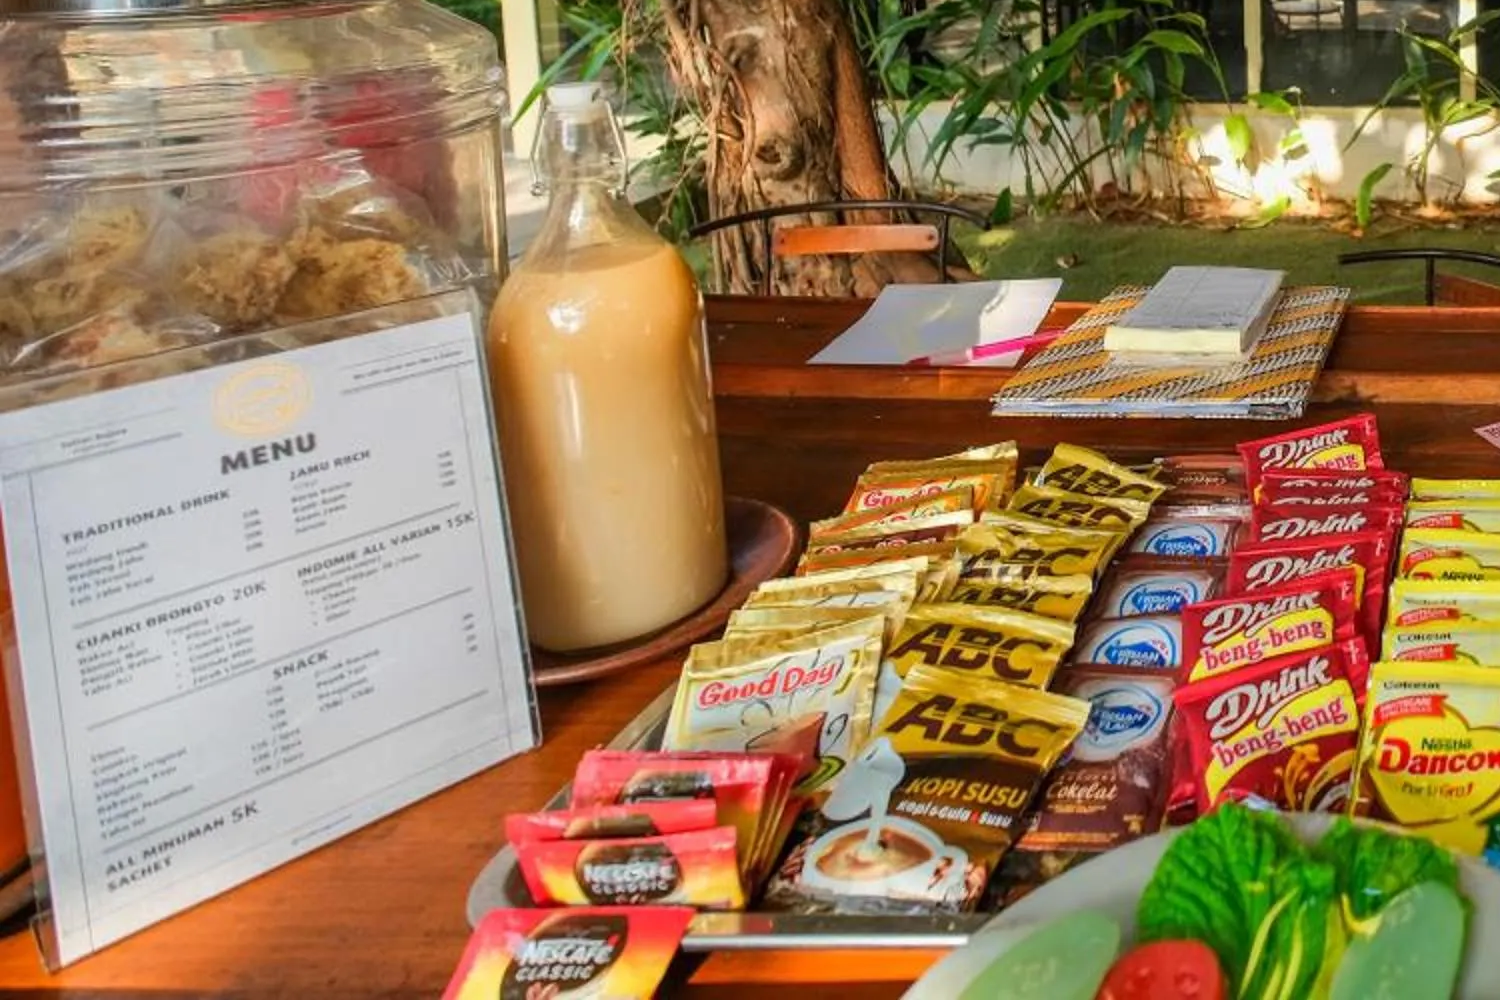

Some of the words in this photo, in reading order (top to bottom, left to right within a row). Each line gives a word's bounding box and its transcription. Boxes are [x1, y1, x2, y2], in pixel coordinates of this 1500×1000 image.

[219, 431, 317, 475] MENU
[1258, 429, 1349, 470] Drink
[62, 503, 175, 544] TRADITIONAL
[180, 488, 230, 511] DRINK
[1261, 512, 1367, 542] Drink
[296, 550, 357, 579] INDOMIE
[362, 540, 386, 556] ALL
[446, 510, 474, 530] 15K
[232, 579, 266, 601] 20K
[1245, 545, 1355, 592] Drink
[1201, 590, 1321, 645] Drink
[272, 649, 328, 680] SNACK
[886, 622, 1052, 681] ABC
[1201, 621, 1327, 670] beng-beng
[699, 674, 778, 708] Good
[782, 661, 837, 693] Day
[1205, 655, 1334, 742] Drink
[884, 694, 1077, 757] ABC
[1212, 696, 1350, 769] beng-beng
[905, 776, 964, 799] KOPI
[962, 780, 1028, 809] SUSU
[105, 852, 136, 877] ALL
[142, 814, 225, 861] MINUMAN
[231, 799, 259, 824] 5K
[107, 854, 172, 893] SACHET
[591, 881, 669, 894] CLASSIC
[515, 963, 595, 983] CLASSIC
